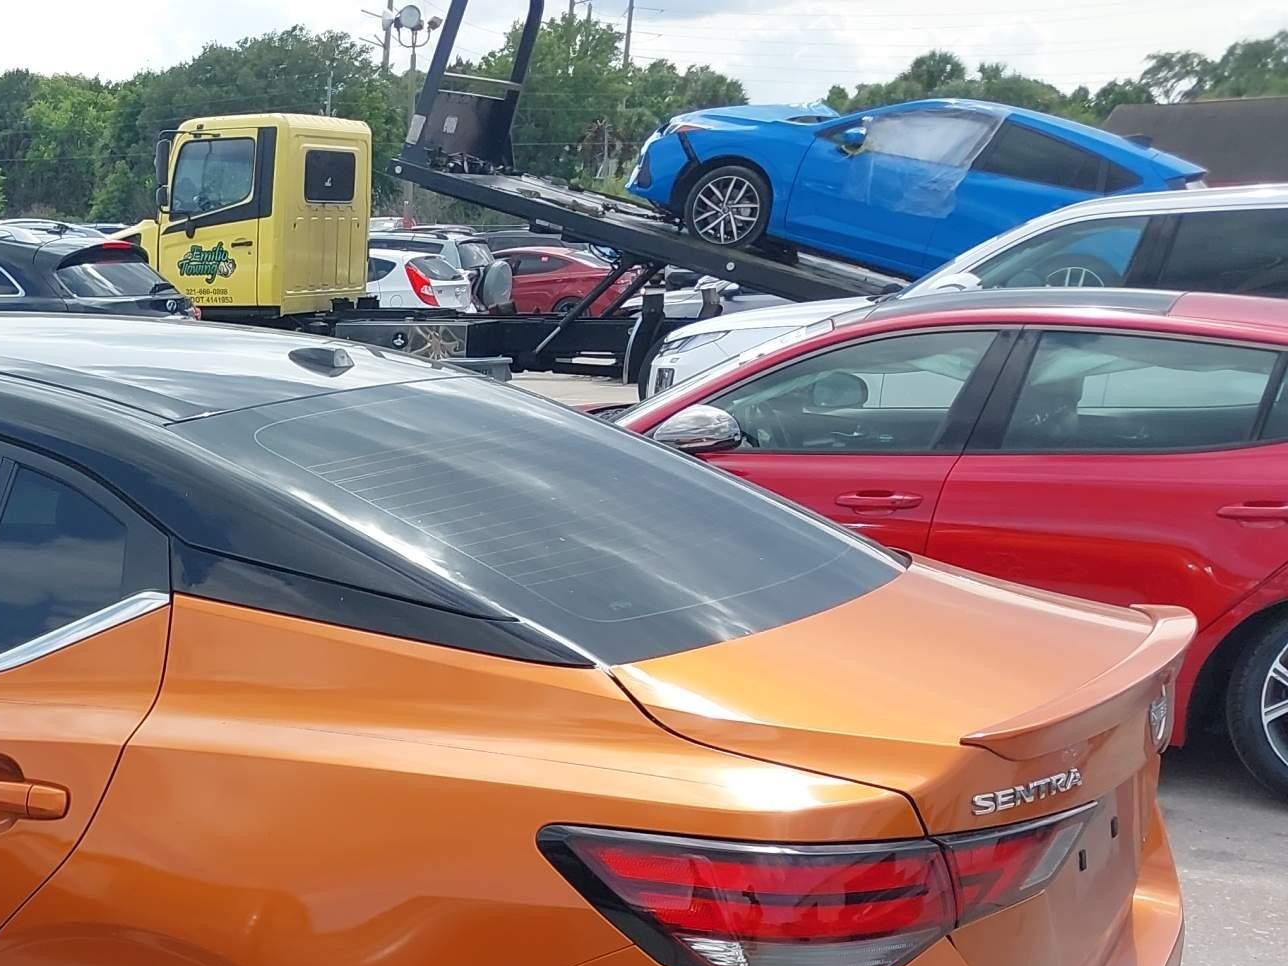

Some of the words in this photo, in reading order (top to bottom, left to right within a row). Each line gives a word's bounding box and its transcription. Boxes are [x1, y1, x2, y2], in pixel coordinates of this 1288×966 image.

[190, 241, 228, 263] Emilio
[177, 260, 217, 284] Towing
[971, 767, 1083, 816] SENTRA
